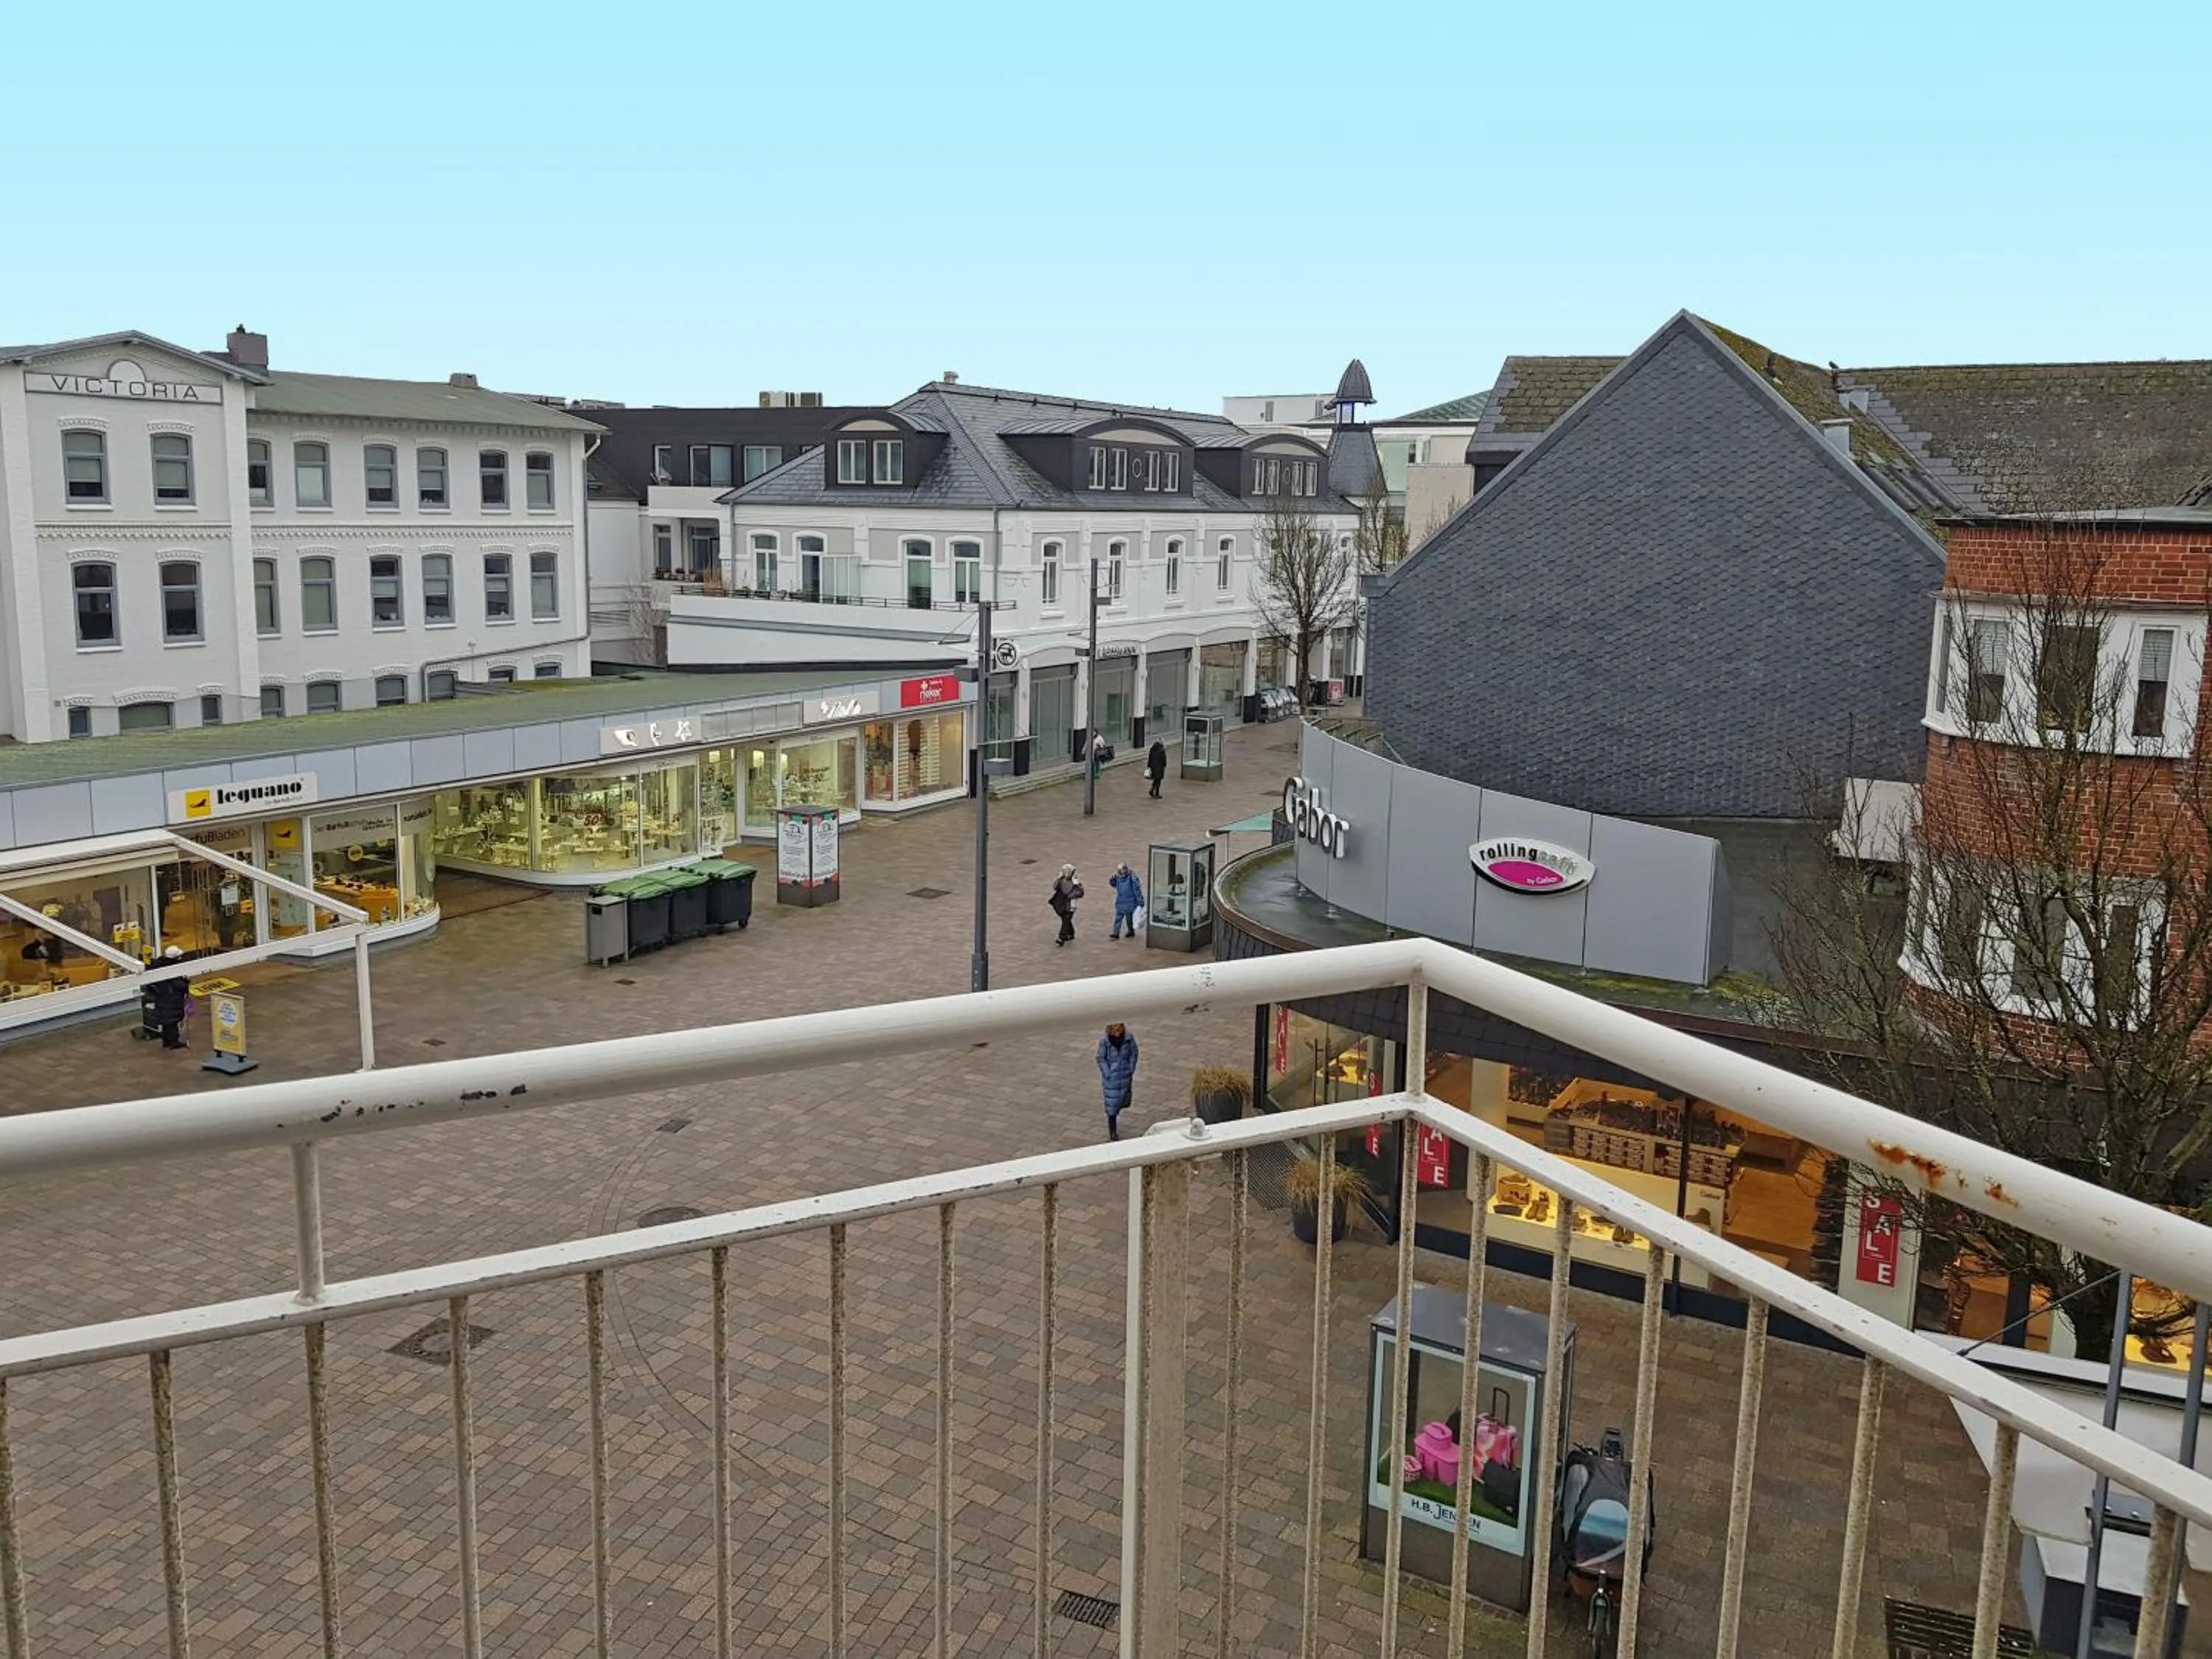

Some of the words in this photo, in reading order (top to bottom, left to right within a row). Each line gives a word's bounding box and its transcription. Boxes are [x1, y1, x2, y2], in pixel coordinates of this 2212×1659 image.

[51, 375, 198, 400] VICTORIA
[217, 782, 302, 804] leguano
[1283, 776, 1350, 860] Gabor
[1411, 1499, 1433, 1514] H.B.
[1433, 1503, 1481, 1529] JENEN
